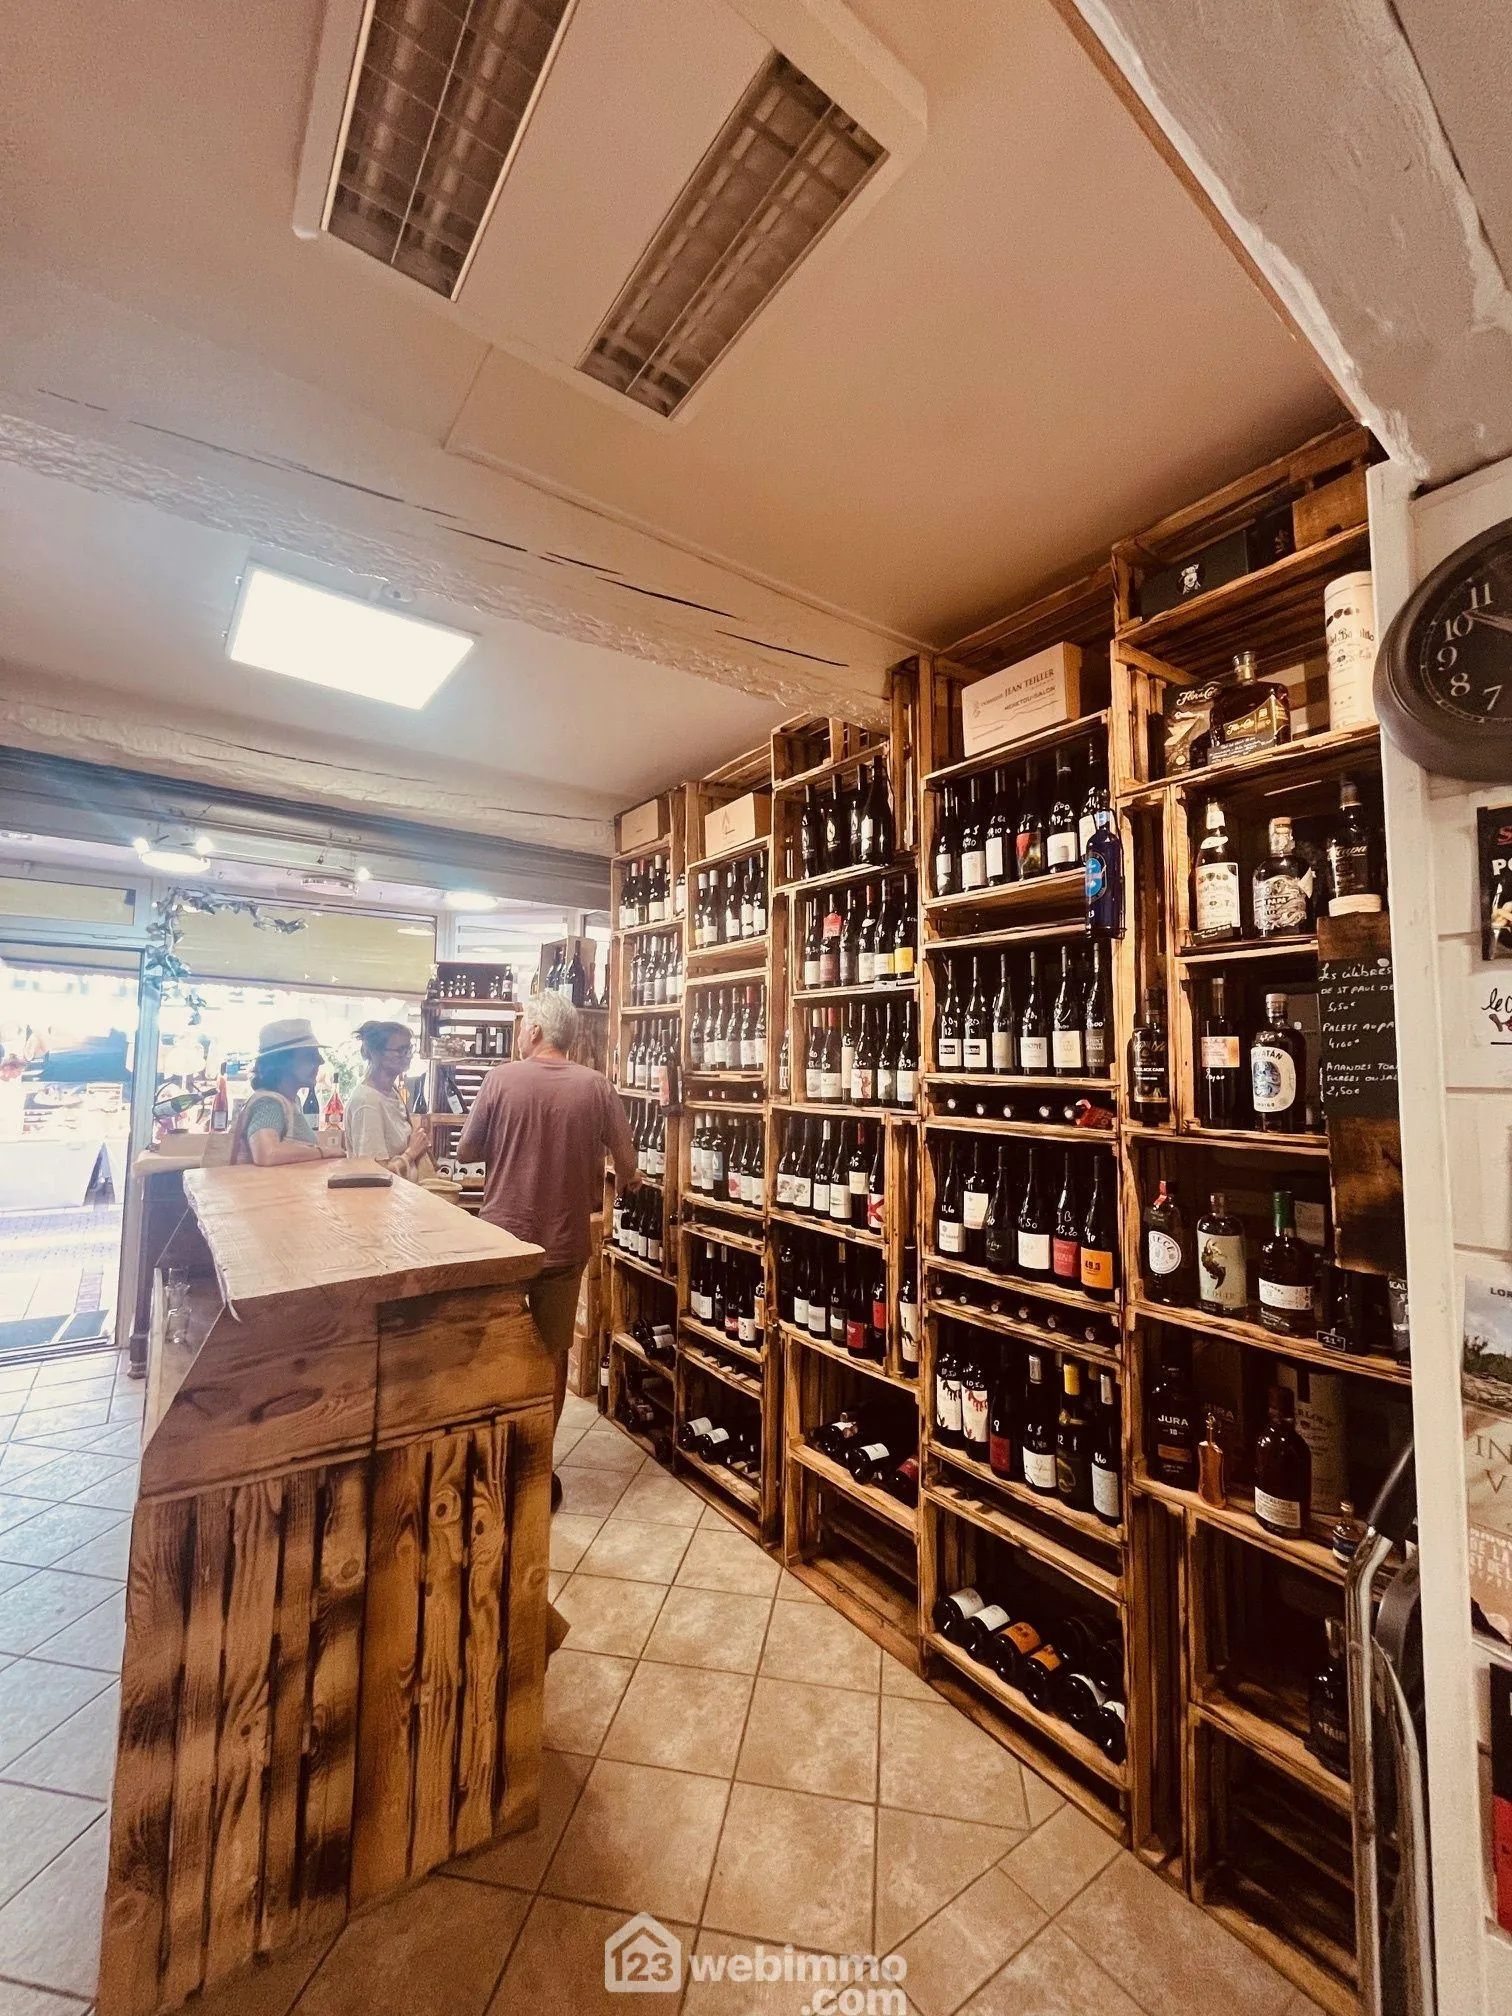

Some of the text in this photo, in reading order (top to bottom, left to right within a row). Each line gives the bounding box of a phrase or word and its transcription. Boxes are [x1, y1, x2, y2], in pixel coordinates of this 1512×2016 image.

[1470, 582, 1494, 610] 11
[1445, 610, 1474, 642] 10
[1437, 645, 1458, 672] 9
[1005, 683, 1023, 697] JEAN
[1024, 668, 1055, 688] TEILLER
[1450, 672, 1471, 697] 8
[1483, 684, 1503, 711] 7
[1321, 986, 1334, 995] DE
[1350, 984, 1376, 995] PAUL
[1323, 1022, 1358, 1033] PALETS
[1157, 1414, 1189, 1427] JURA
